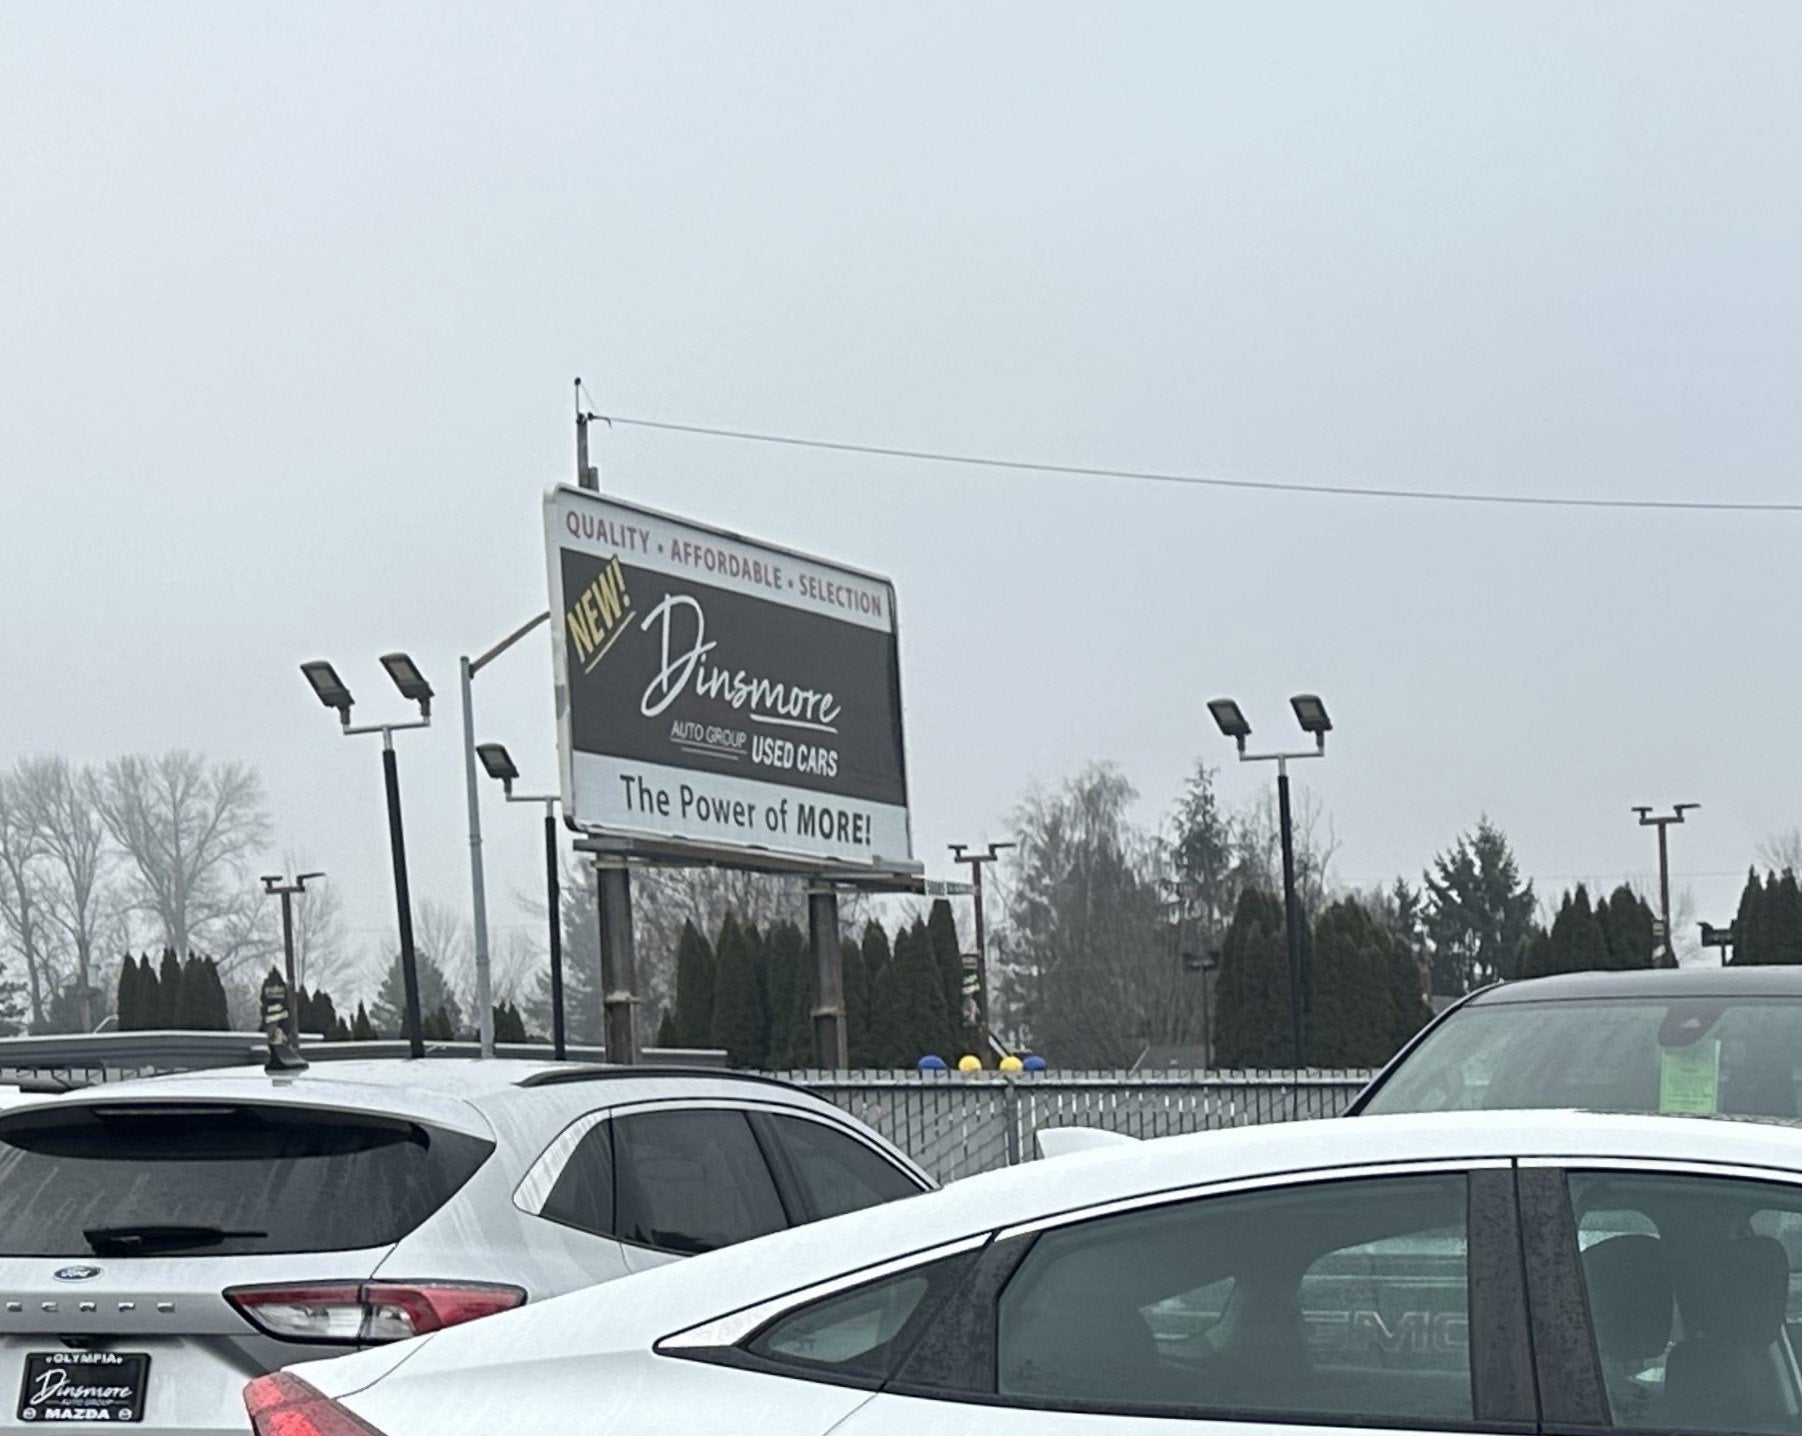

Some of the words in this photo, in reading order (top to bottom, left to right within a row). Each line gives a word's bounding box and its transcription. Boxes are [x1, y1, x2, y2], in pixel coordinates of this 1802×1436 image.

[566, 511, 650, 554] QUALITY
[671, 539, 782, 589] AFFORDABLE
[799, 574, 882, 617] SELECTION
[566, 553, 631, 664] NEW!
[640, 593, 841, 723] Dinsmore
[671, 720, 703, 740] AUTO
[706, 726, 748, 748] GROUP
[751, 734, 794, 768] USED
[796, 743, 838, 777] CARS
[619, 774, 670, 817] The
[680, 784, 756, 828] Power
[765, 798, 788, 833] of
[797, 803, 871, 845] MORE!
[53, 1353, 116, 1363] OLYMPIA
[30, 1368, 133, 1405] Dinsmore
[45, 1408, 110, 1419] MAZDA
